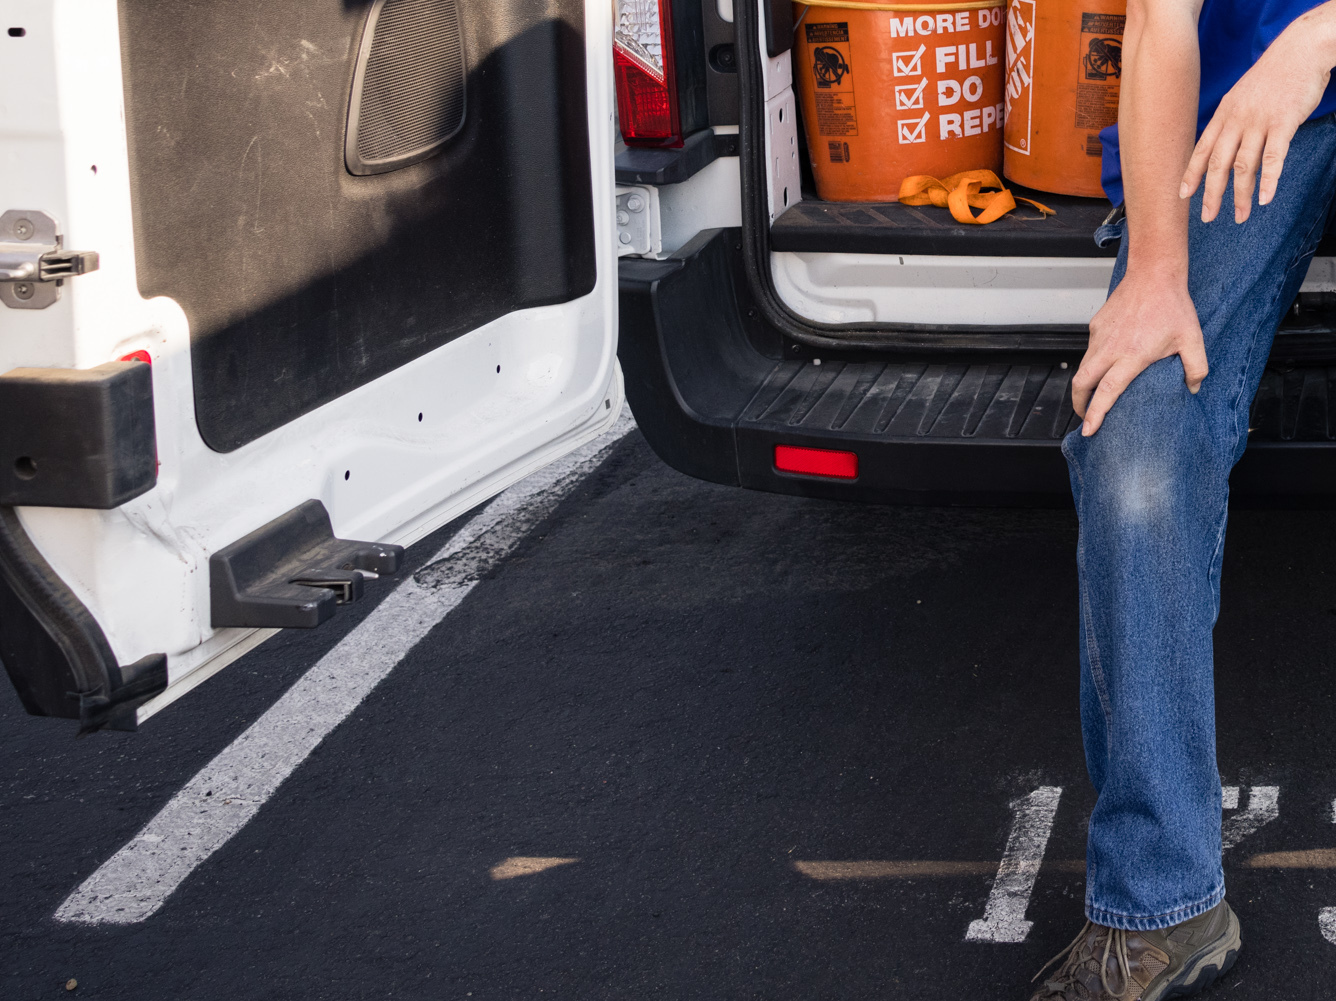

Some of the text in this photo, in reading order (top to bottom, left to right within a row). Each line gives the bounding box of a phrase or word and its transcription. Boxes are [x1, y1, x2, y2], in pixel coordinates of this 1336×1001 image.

[890, 11, 971, 38] MORE
[935, 40, 998, 73] FILL
[937, 75, 984, 107] DO
[939, 102, 1005, 140] REPE
